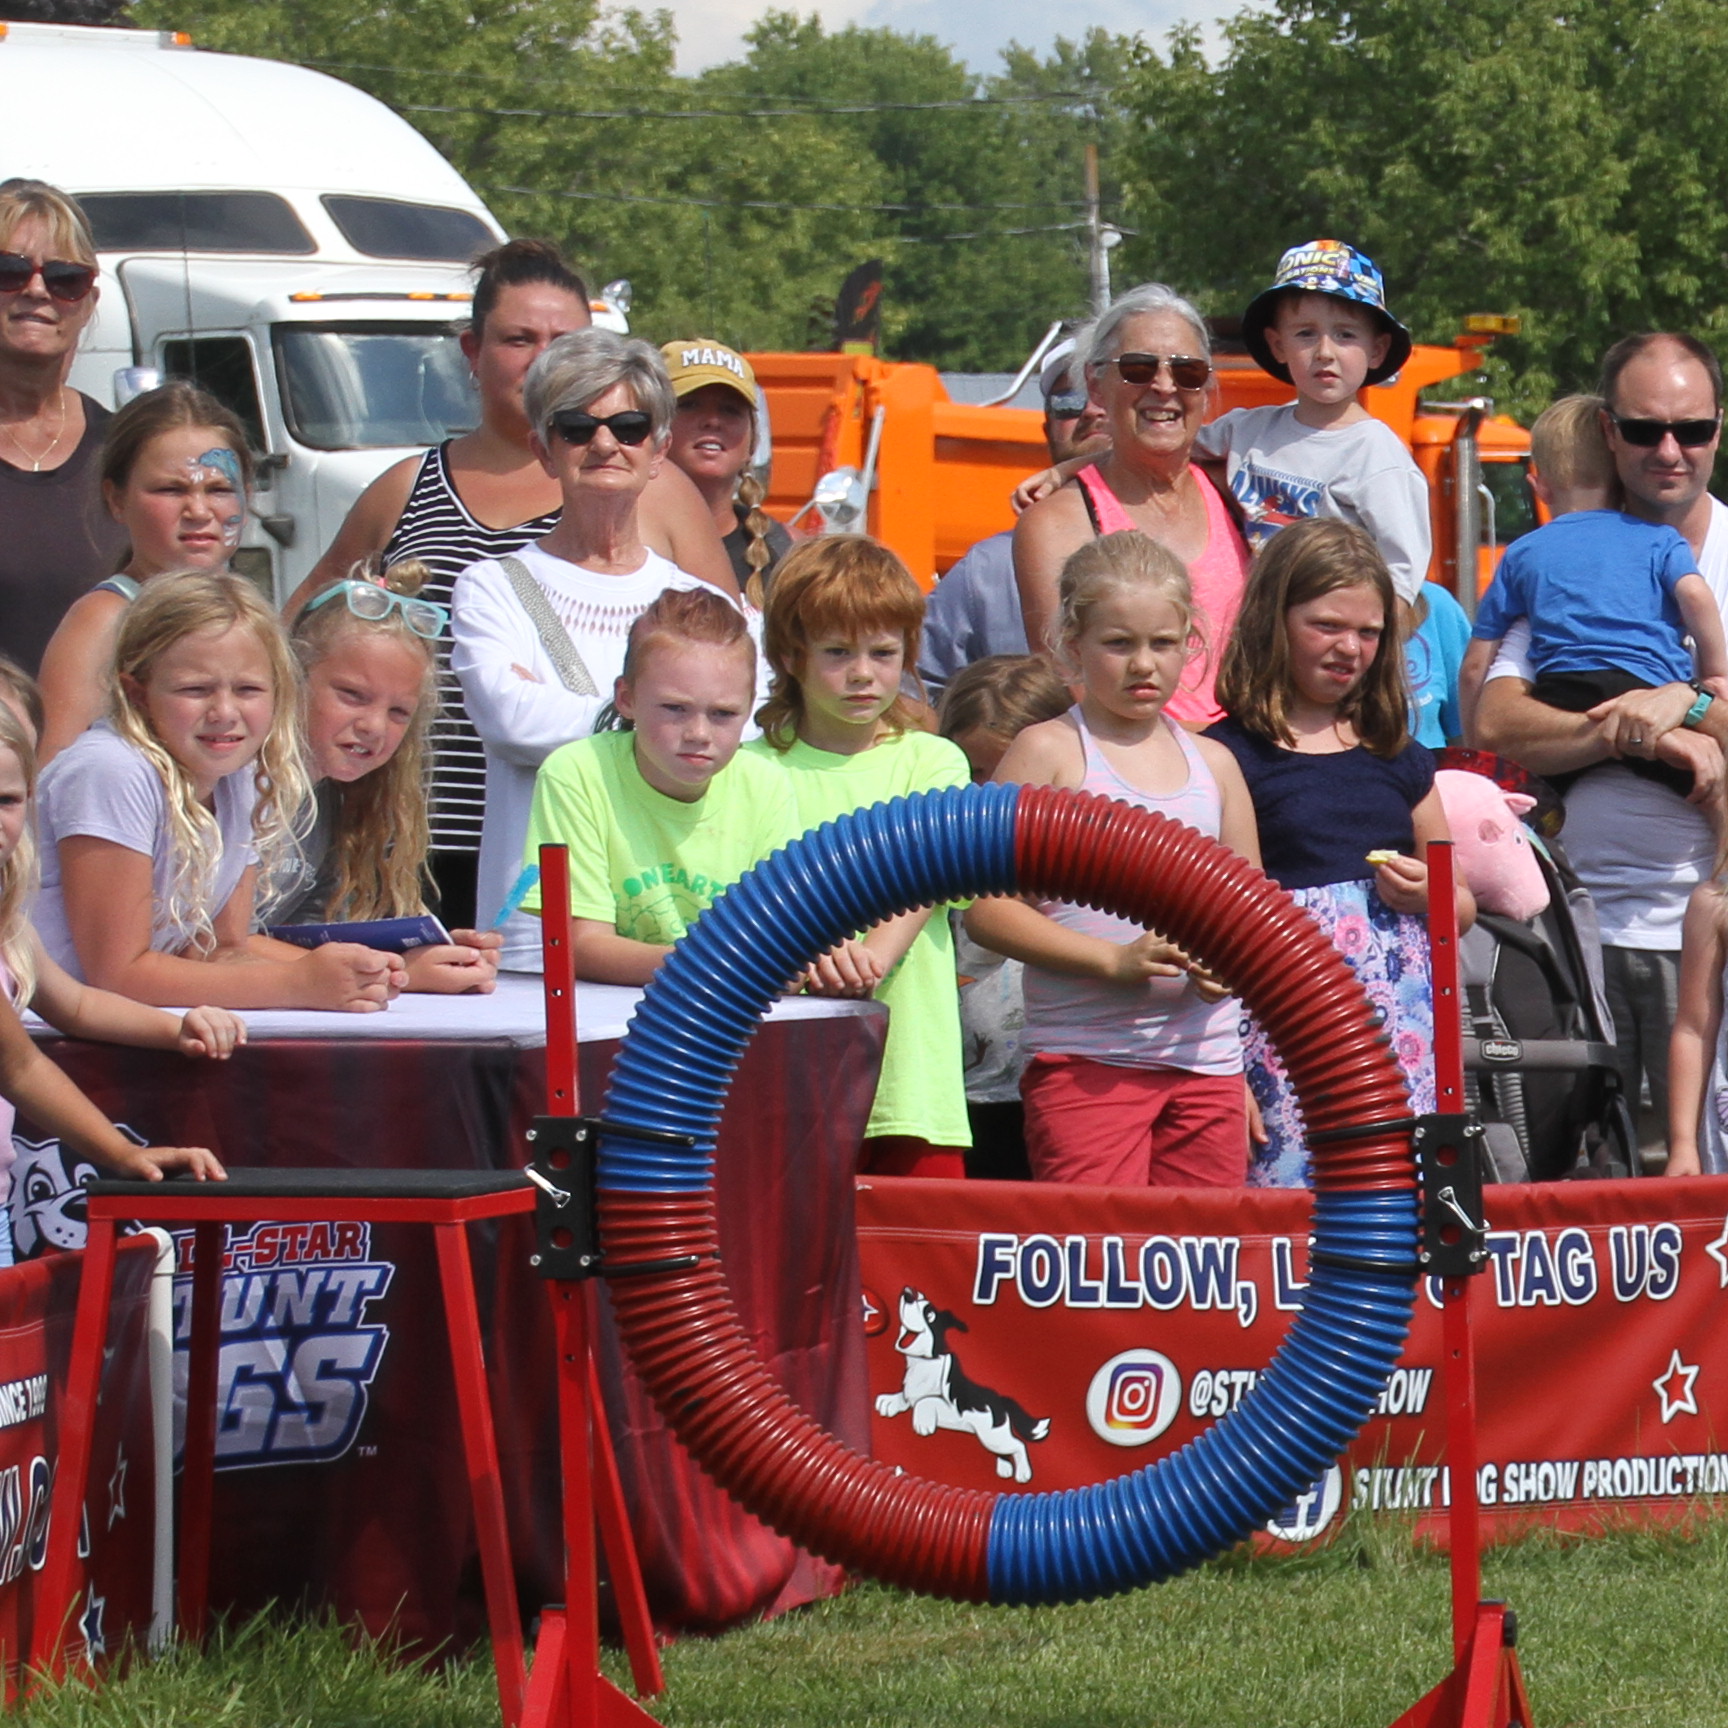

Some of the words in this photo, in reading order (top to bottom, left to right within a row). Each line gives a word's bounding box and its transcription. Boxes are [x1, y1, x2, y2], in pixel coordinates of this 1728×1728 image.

[682, 347, 744, 379] MAMA
[973, 1233, 1257, 1327] FOLLOW,
[1485, 1228, 1598, 1306] TAG
[1609, 1223, 1682, 1301] US
[1503, 1461, 1579, 1503] SHOW
